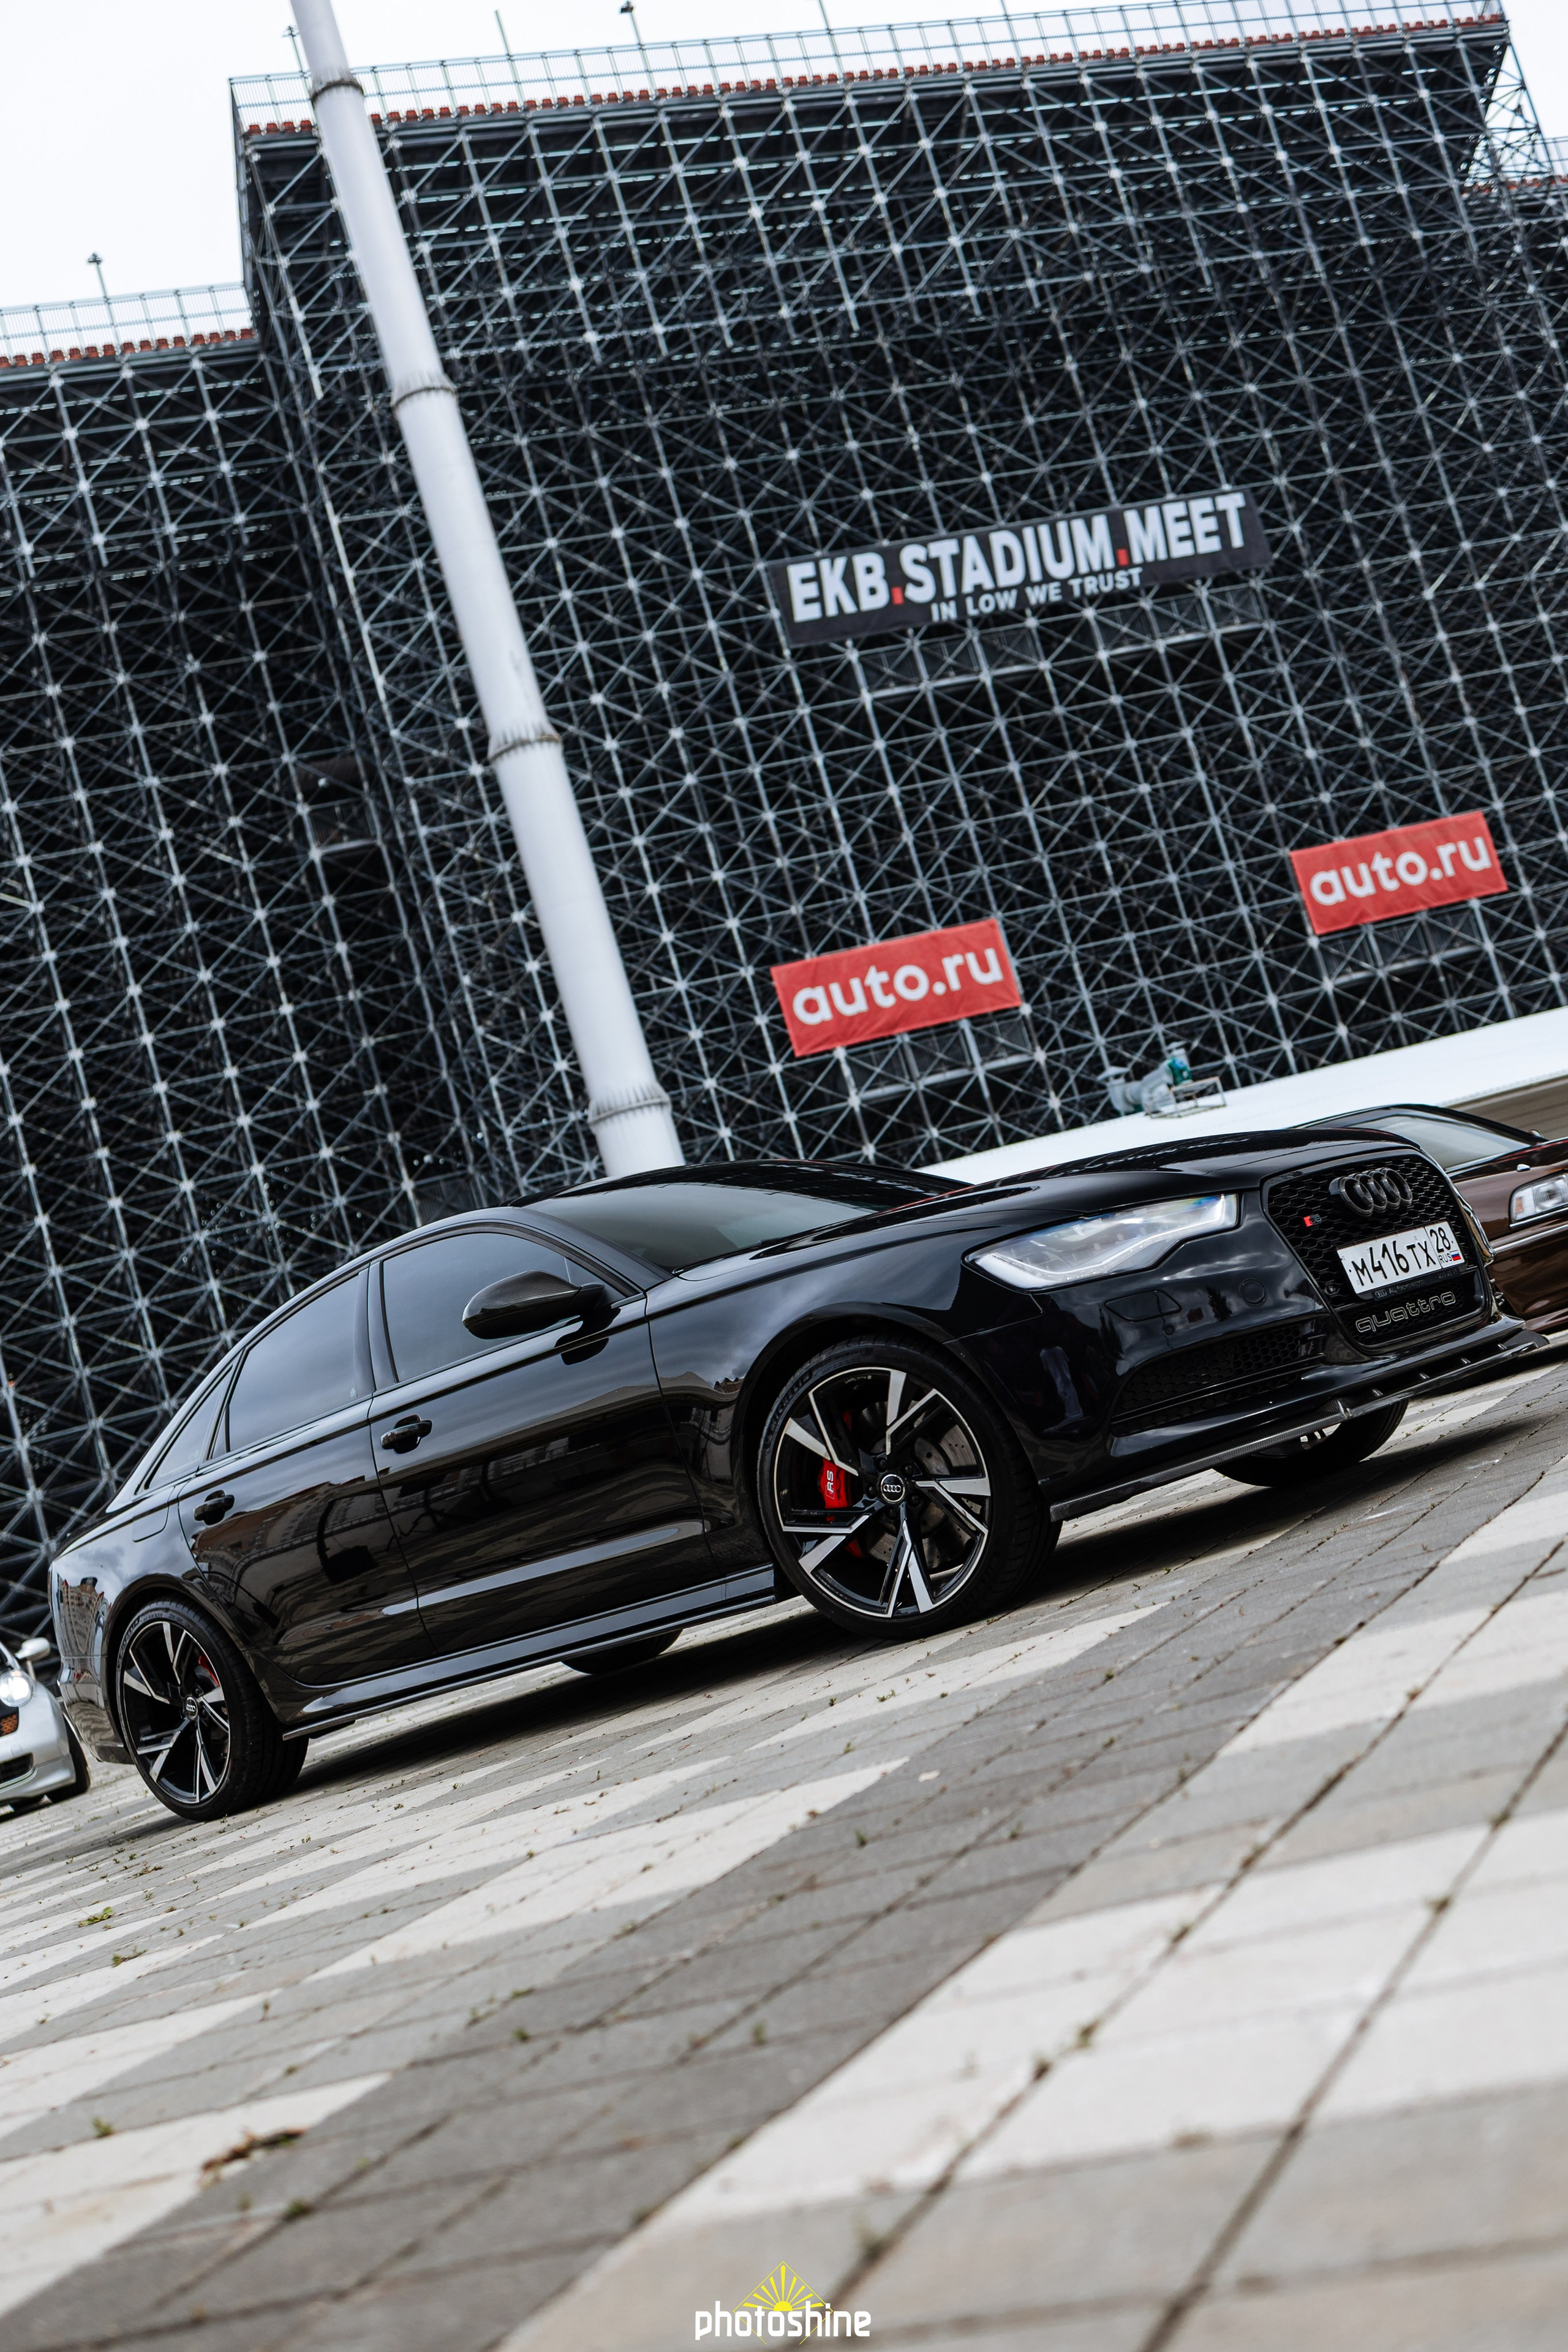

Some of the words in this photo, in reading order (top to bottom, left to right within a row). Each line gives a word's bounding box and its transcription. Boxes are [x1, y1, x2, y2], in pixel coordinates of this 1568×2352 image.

[786, 492, 1246, 623] EKB.STADIUM.MEET
[930, 600, 958, 622] IN
[965, 589, 1018, 616] LOW
[1025, 582, 1063, 606] WE
[1068, 567, 1144, 598] TRUST
[1310, 836, 1492, 906] auto.ru
[792, 948, 1004, 1025] auto.ru
[1429, 1227, 1451, 1253] 28
[1438, 1253, 1453, 1264] RUS
[1355, 1291, 1457, 1333] quattro
[771, 1371, 810, 1431] MICHELIN
[826, 1470, 834, 1493] RS
